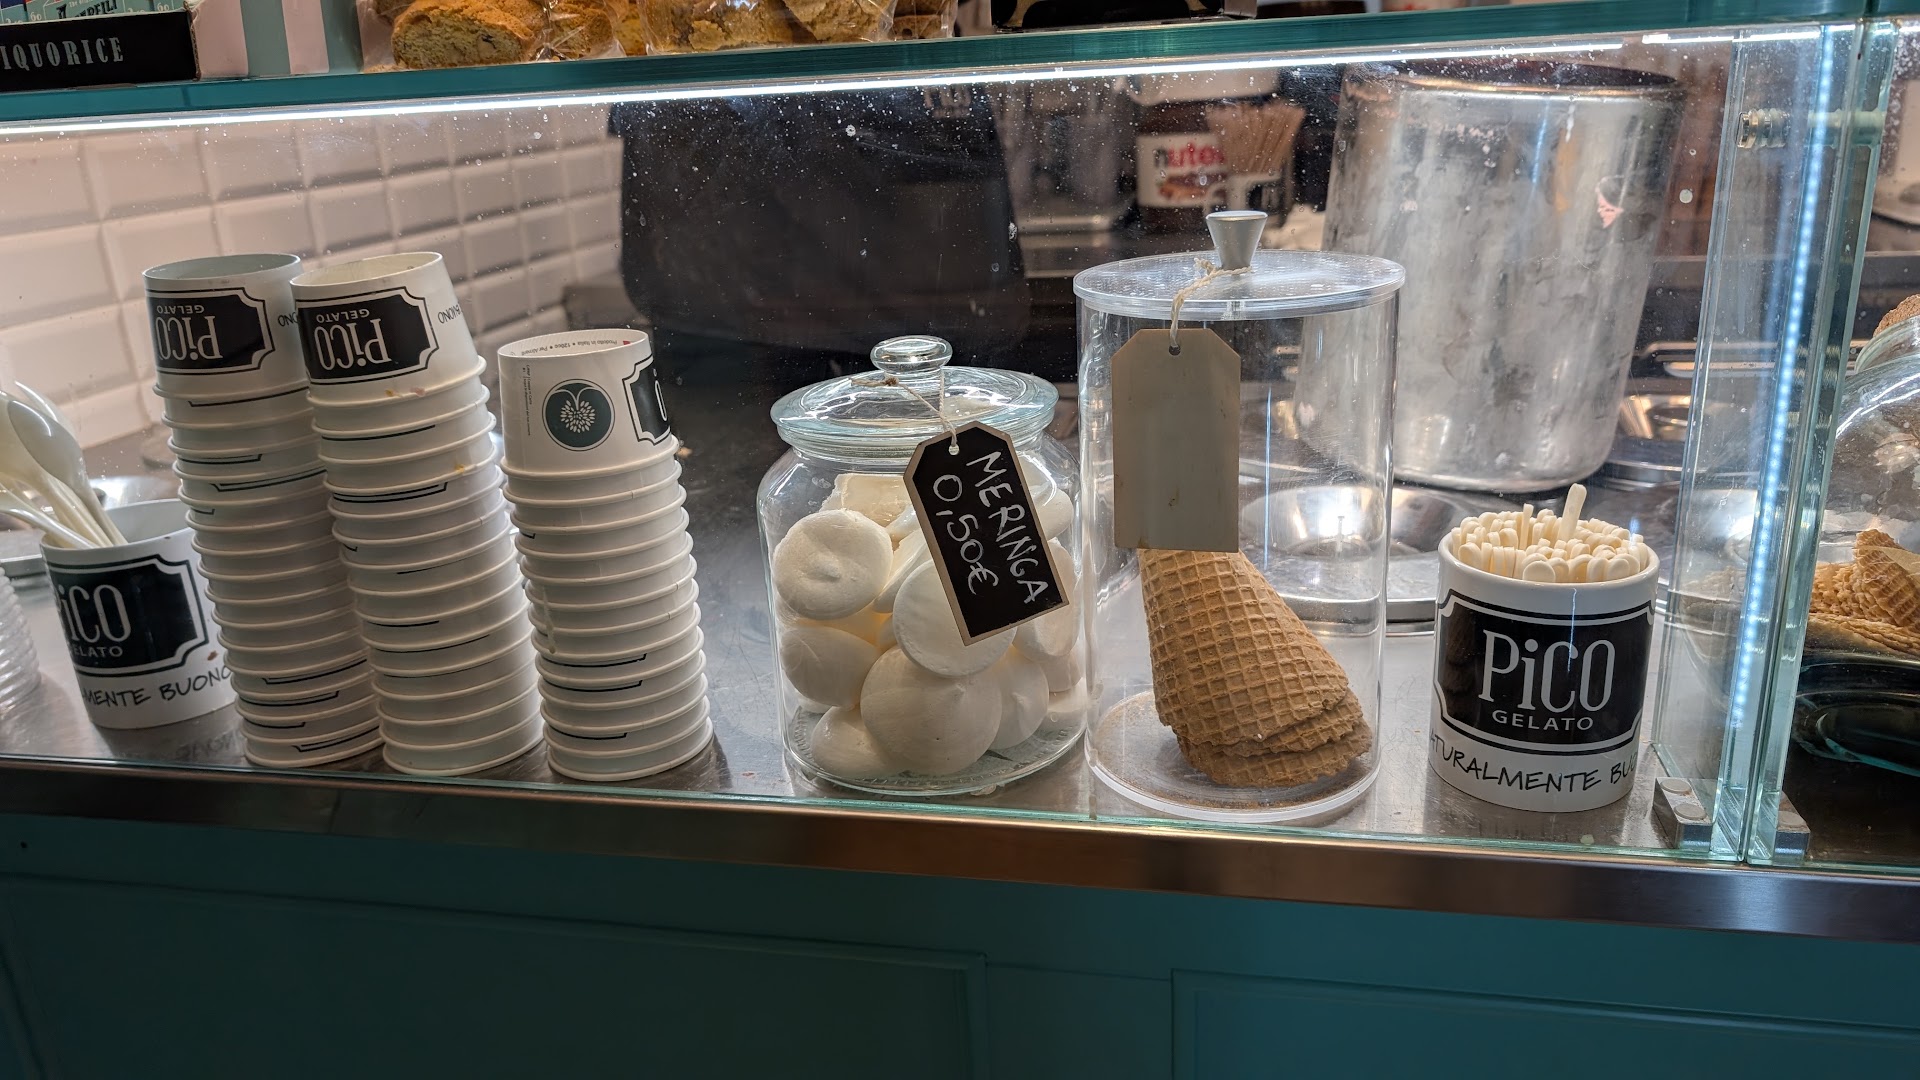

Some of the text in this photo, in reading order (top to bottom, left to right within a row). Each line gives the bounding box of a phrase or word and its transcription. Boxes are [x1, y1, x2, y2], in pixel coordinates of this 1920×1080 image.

[0, 37, 124, 71] IQUORICE
[156, 304, 205, 314] GELATO
[316, 308, 370, 324] GELATO
[314, 318, 392, 371] PiCO
[966, 451, 1048, 604] MERINGA
[58, 584, 131, 643] iCO
[70, 645, 123, 657] ELATO
[1478, 629, 1616, 713] PiCO
[1492, 710, 1594, 731] GELATO
